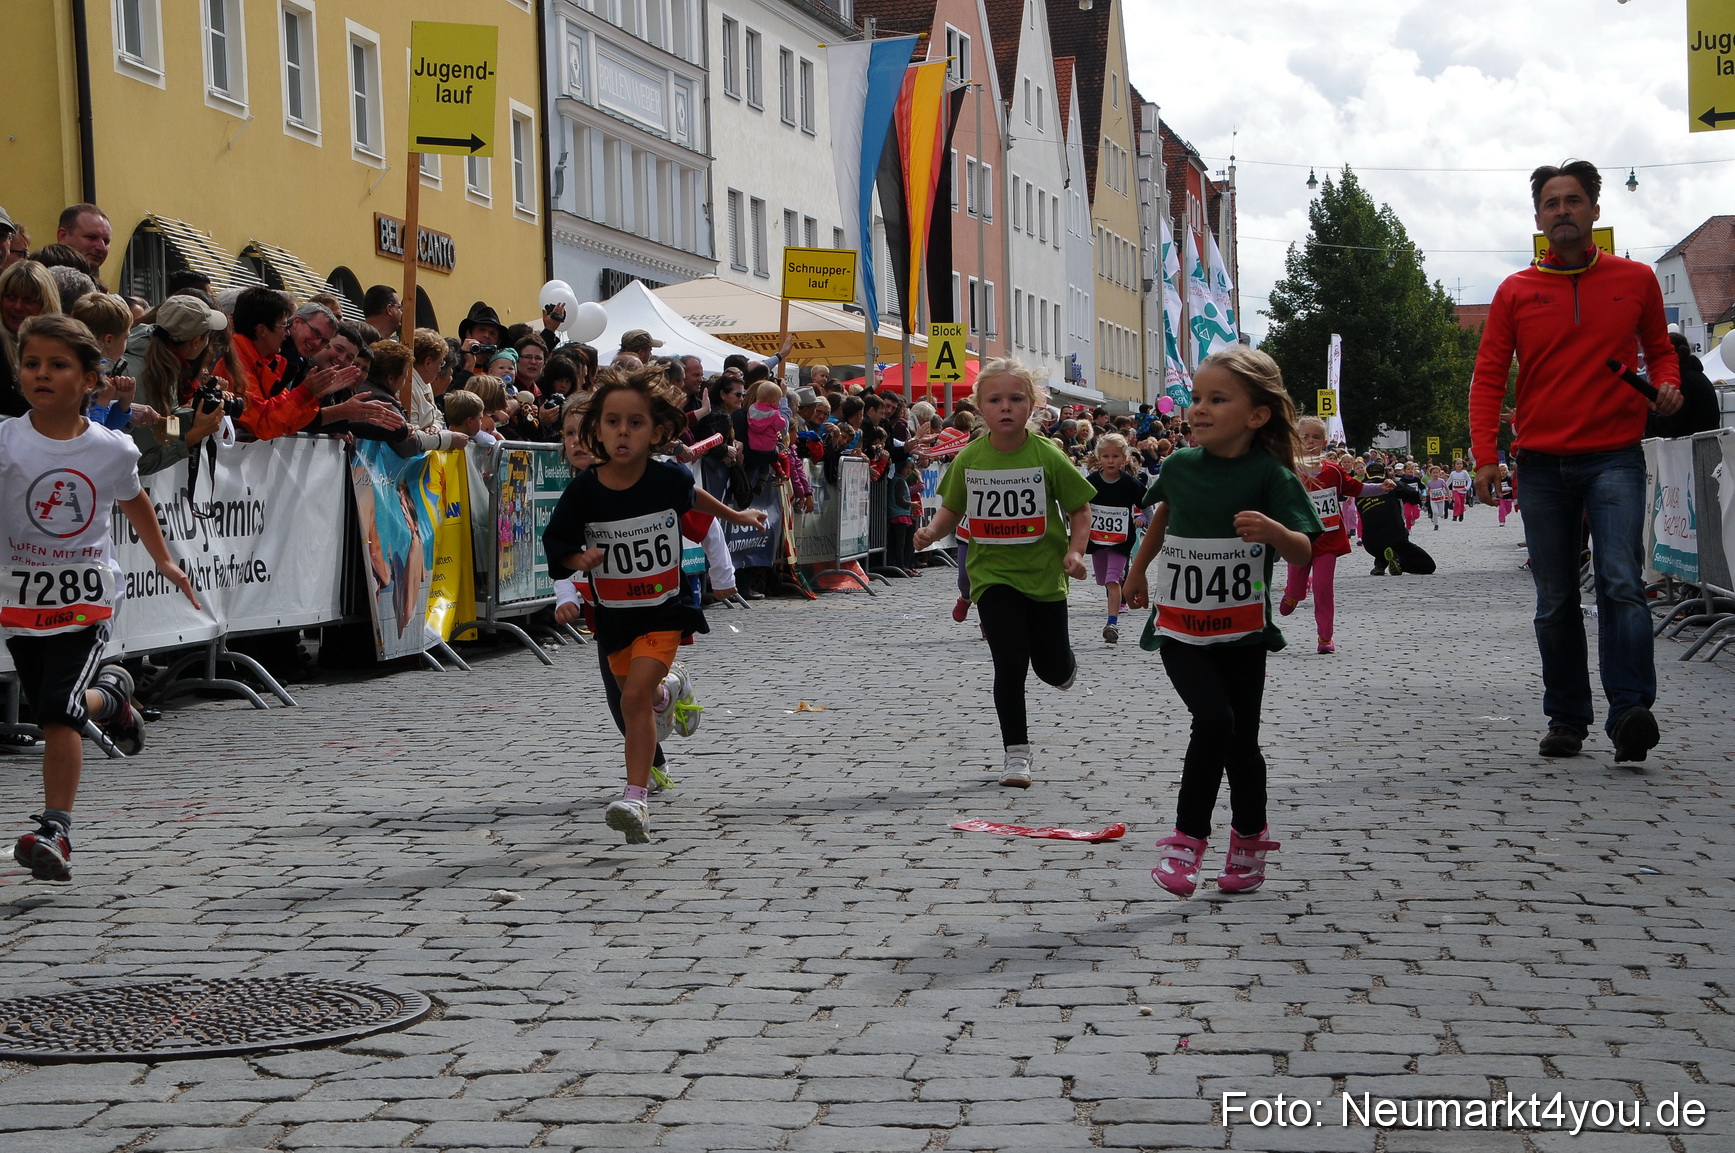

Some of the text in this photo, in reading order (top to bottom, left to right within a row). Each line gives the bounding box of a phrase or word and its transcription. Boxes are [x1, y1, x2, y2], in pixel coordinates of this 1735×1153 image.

[1690, 30, 1735, 54] Jug
[414, 57, 494, 83] Jugend-
[1716, 55, 1735, 76] la
[436, 83, 473, 104] lauf
[788, 262, 851, 277] Schnupper-
[808, 278, 829, 288] lauf
[932, 325, 962, 336] Block
[935, 341, 957, 369] A
[1322, 398, 1332, 411] B
[1430, 442, 1437, 451] C
[966, 476, 1031, 486] PARTL Neumarkt
[972, 488, 1037, 517] 7203
[586, 522, 663, 539] PARTL Neumarkt
[983, 522, 1027, 535] Victoria
[1091, 515, 1123, 532] 7393
[52, 549, 77, 559] MIT
[596, 533, 672, 575] 7056
[1160, 545, 1246, 560] PARTL Neumarkt
[11, 568, 104, 605] 7289
[626, 582, 655, 596] Jeta
[1166, 562, 1252, 604] 7048
[34, 610, 74, 627] Luisa
[1182, 613, 1232, 632] Vivien
